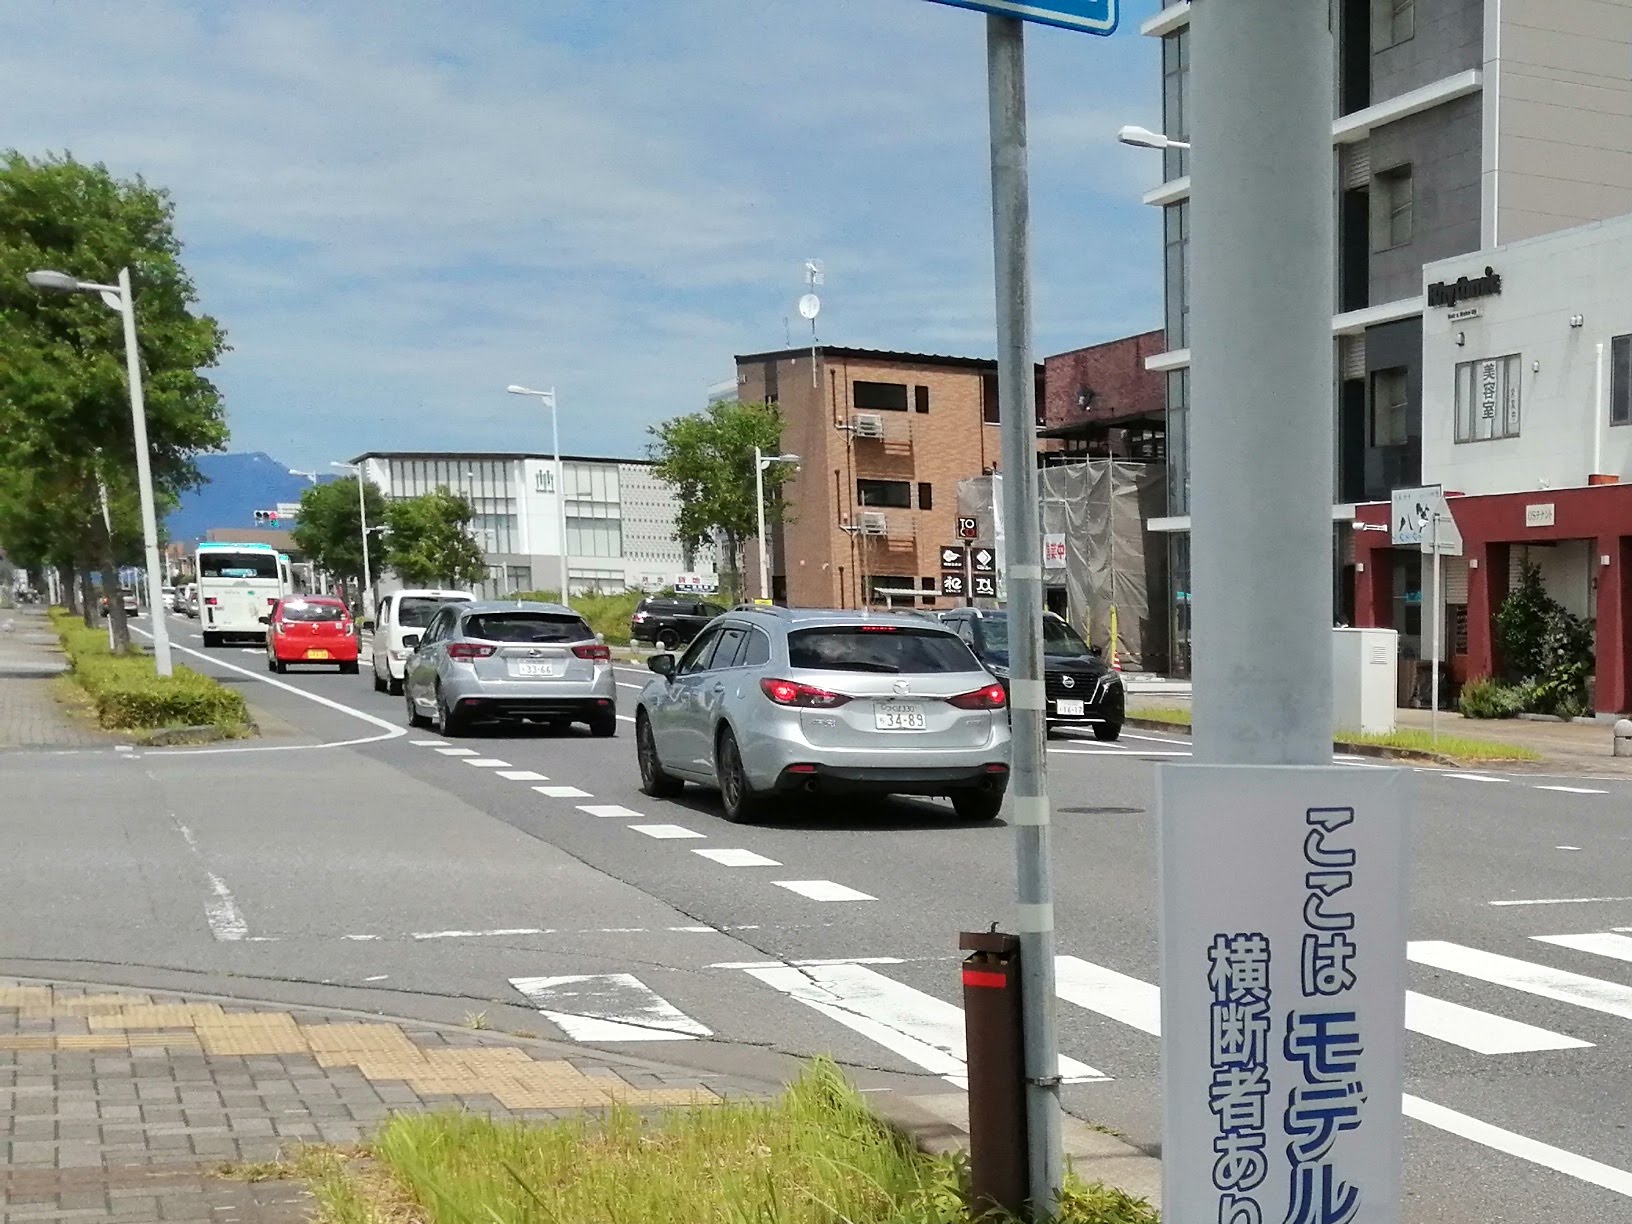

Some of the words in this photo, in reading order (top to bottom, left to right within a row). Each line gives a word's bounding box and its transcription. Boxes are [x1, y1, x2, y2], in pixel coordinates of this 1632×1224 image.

[1482, 362, 1496, 420] 美容室
[886, 713, 924, 727] 34-89
